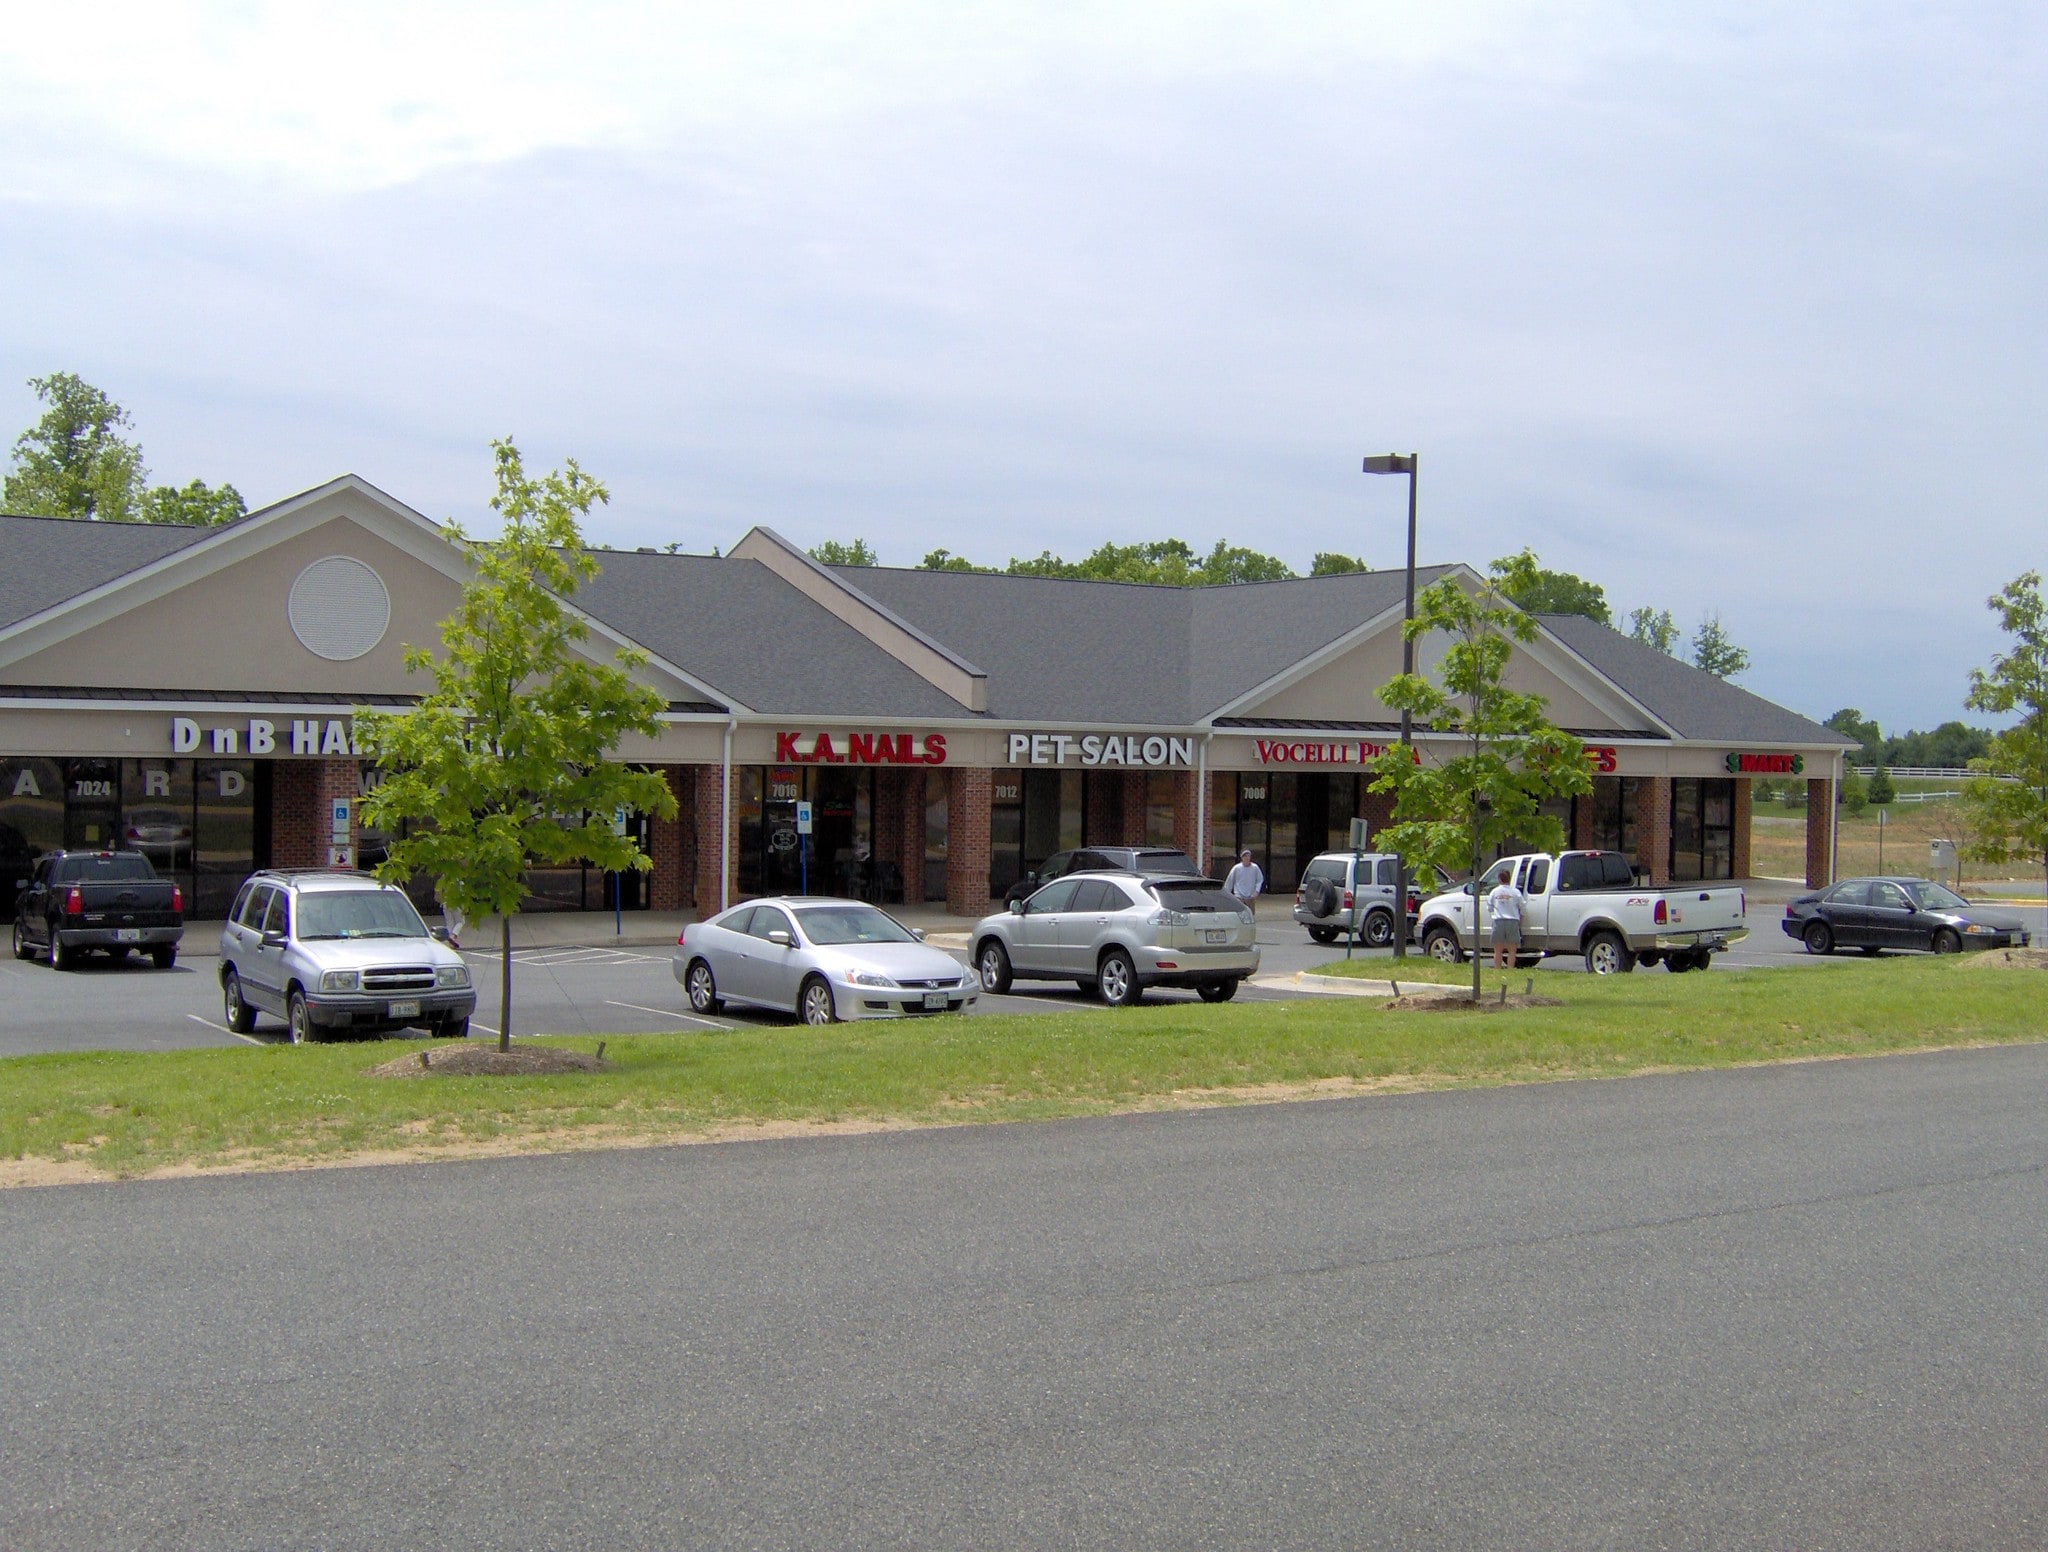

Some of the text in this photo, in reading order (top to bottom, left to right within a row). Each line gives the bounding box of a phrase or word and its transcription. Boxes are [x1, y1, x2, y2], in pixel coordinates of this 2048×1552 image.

[849, 733, 948, 765] NAILS
[1008, 734, 1193, 766] PET SALON
[1254, 740, 1348, 765] VOCELLI
[75, 780, 111, 796] 7024
[772, 784, 798, 798] 7016
[995, 785, 1018, 799] 7012
